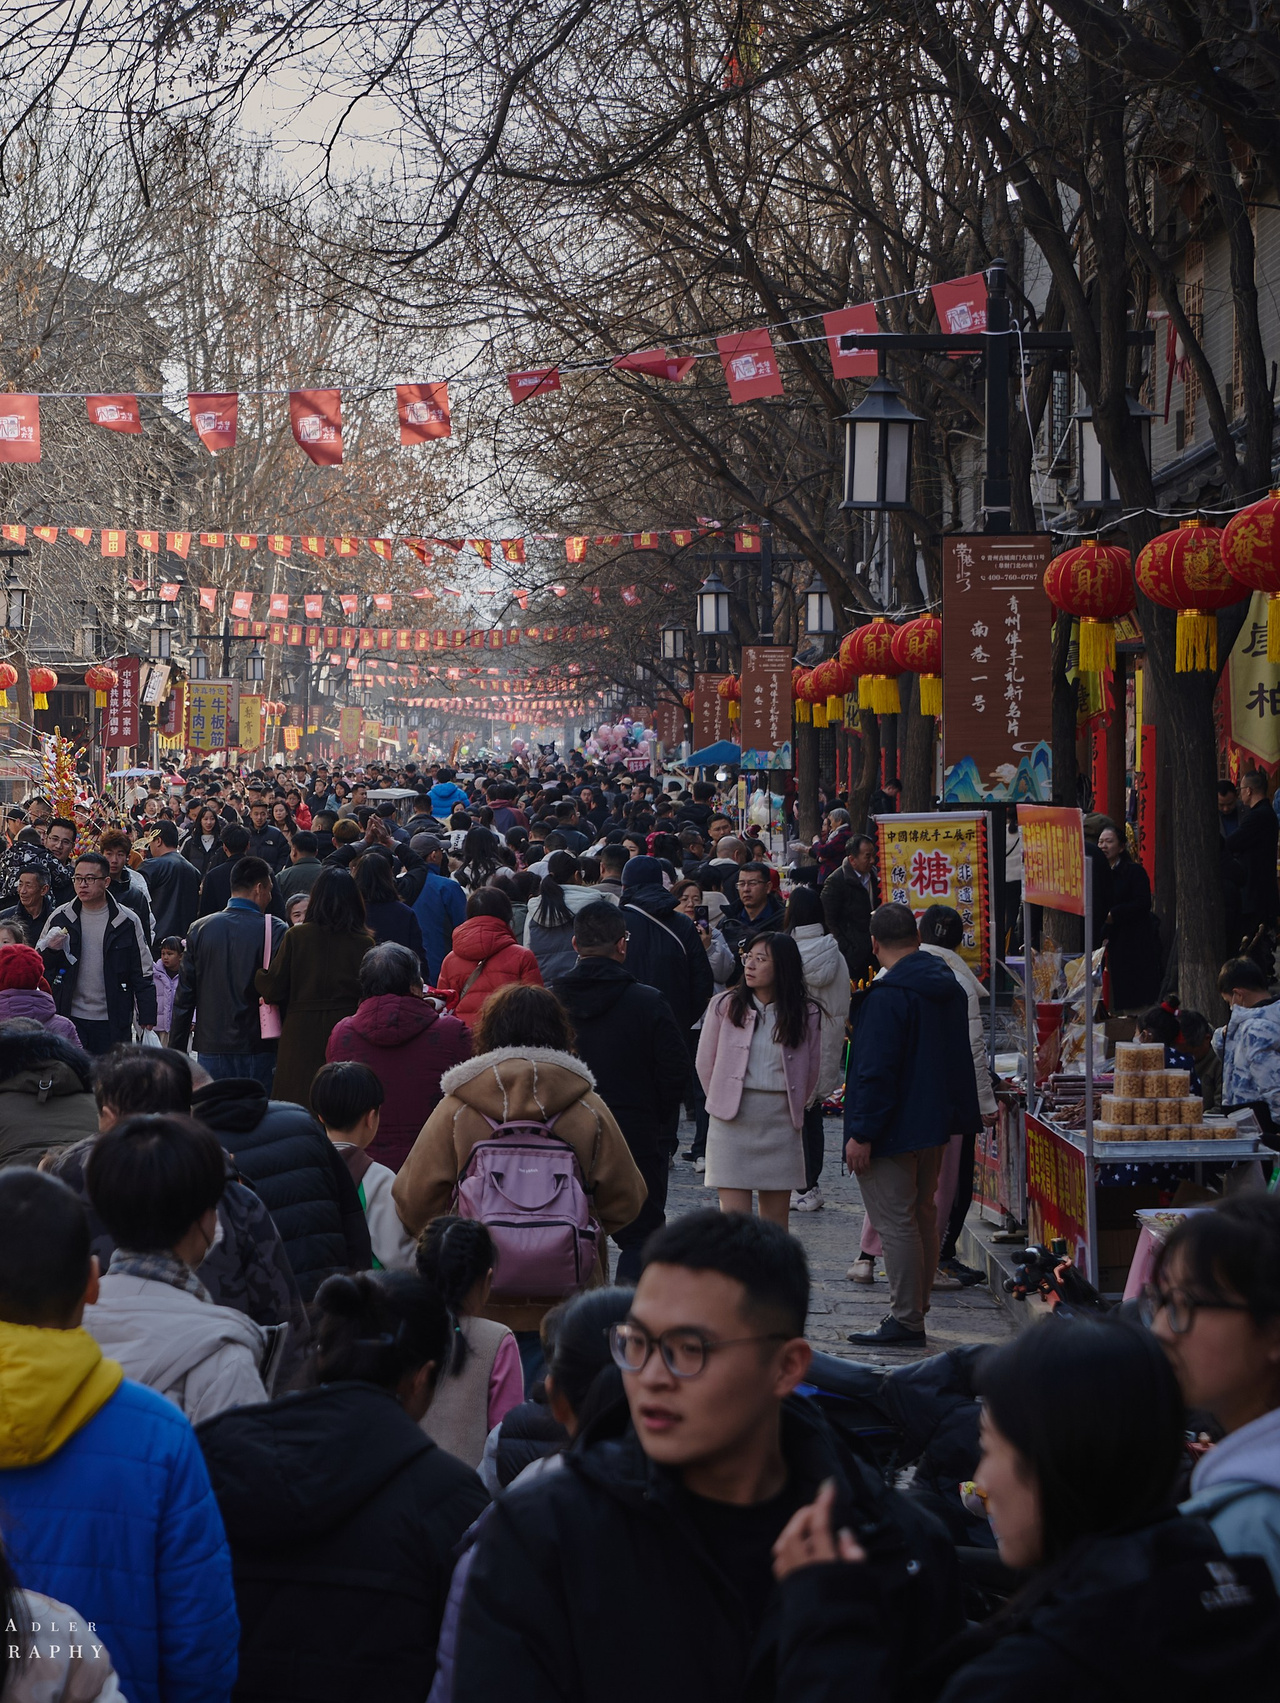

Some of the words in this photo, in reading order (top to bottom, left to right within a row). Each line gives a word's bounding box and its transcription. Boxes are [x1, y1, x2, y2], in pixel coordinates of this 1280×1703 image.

[109, 531, 118, 552] 自由
[1075, 567, 1105, 598] 財
[865, 638, 886, 662] 財
[904, 633, 929, 658] 財
[970, 620, 990, 713] 南巷一号
[1004, 595, 1025, 736] 青州伴手礼新名片
[110, 685, 119, 736] 共筑中国梦
[122, 670, 132, 736] 中华民族一家亲
[191, 697, 207, 746] 牛肉干
[210, 698, 226, 747] 牛板筋
[886, 829, 975, 844] 中國傳統手工展示
[910, 851, 953, 904] 糖
